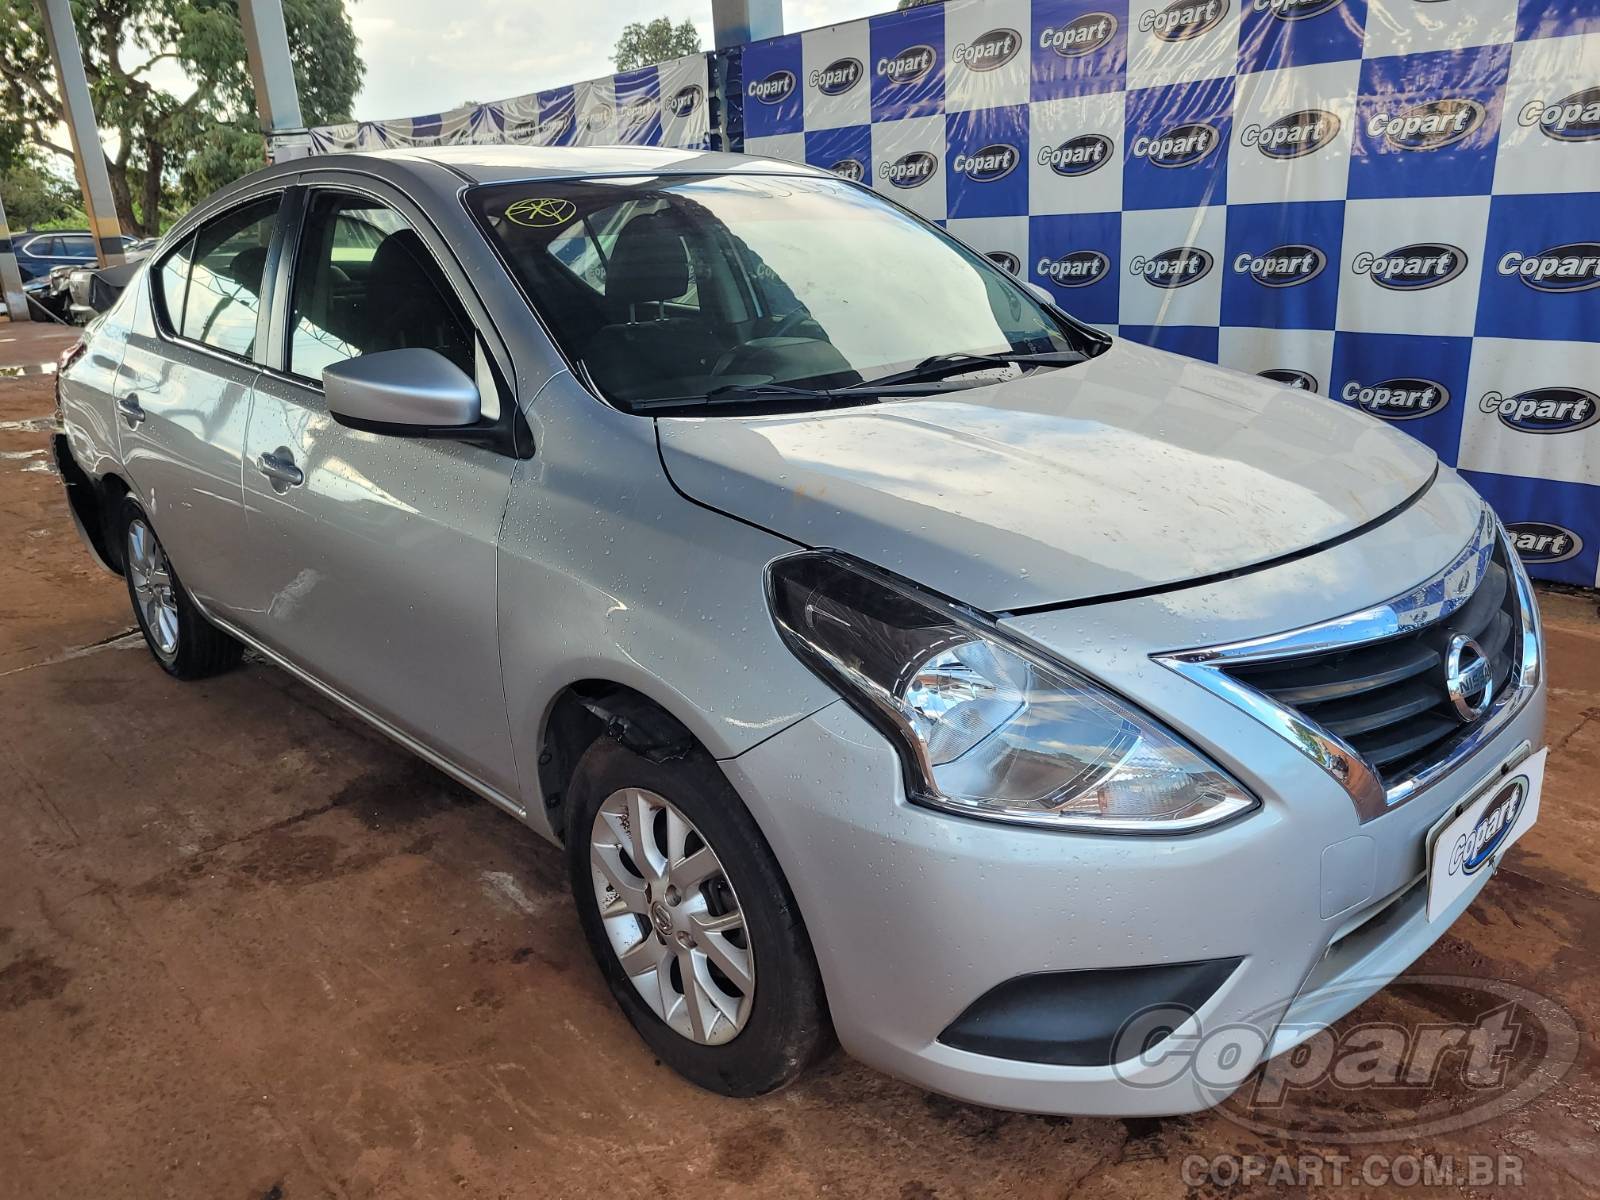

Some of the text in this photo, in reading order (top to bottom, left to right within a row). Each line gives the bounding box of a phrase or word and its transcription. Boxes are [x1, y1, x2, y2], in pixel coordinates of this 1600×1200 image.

[1139, 1, 1214, 36] Copart
[952, 34, 1012, 67] Copart
[1040, 17, 1107, 53] Copart
[809, 65, 856, 93] Copart
[877, 50, 930, 80] Copart
[748, 71, 790, 100] Copart
[1367, 106, 1469, 143] Copart
[1518, 100, 1600, 131] Copa
[1133, 130, 1209, 160] Copart
[1241, 118, 1325, 151] Copart
[954, 148, 1011, 178] Copart
[1038, 139, 1104, 173] Copart
[879, 160, 930, 186] Copart
[1037, 256, 1102, 280] Copart
[1130, 252, 1199, 282] Copart
[1234, 249, 1315, 281] Copart
[1352, 248, 1452, 282] Copart
[1341, 381, 1436, 413] Copart
[1479, 392, 1588, 427] Copart
[1505, 530, 1568, 555] part
[1448, 786, 1519, 876] Copart
